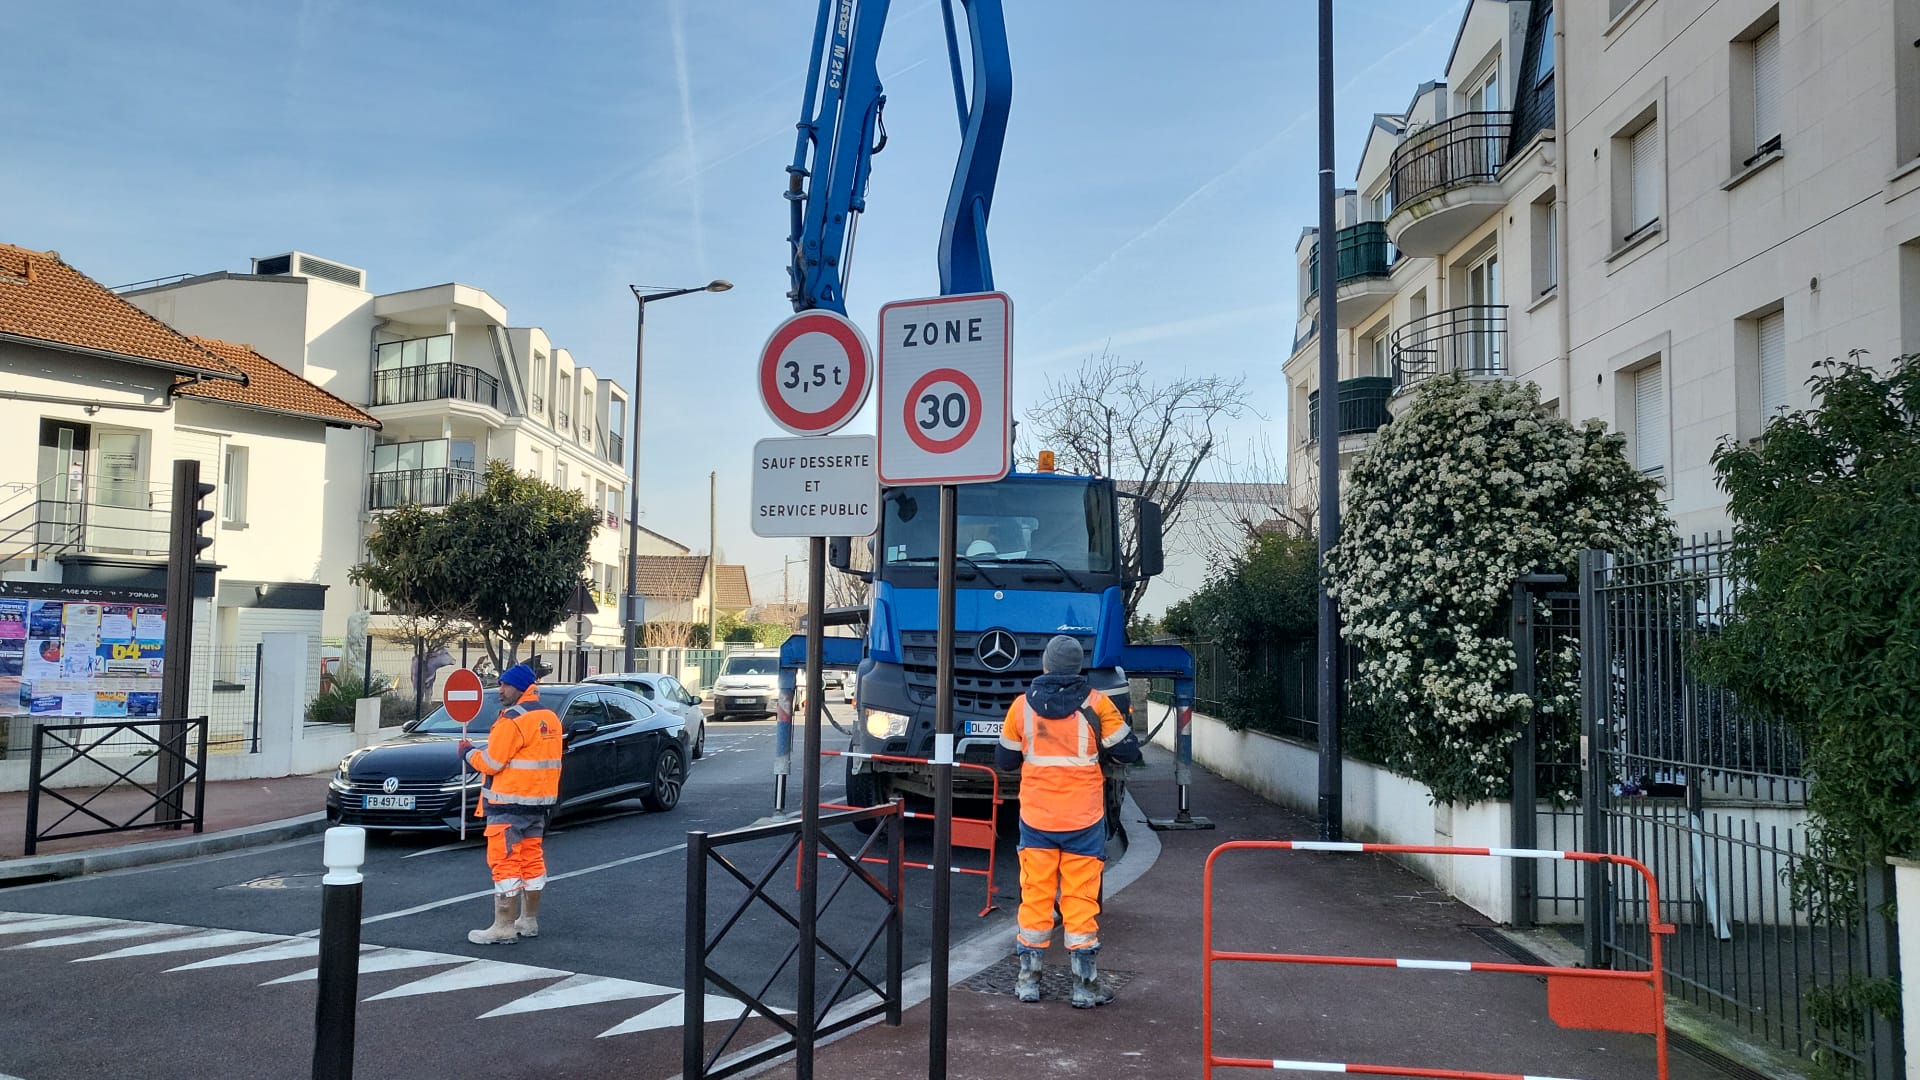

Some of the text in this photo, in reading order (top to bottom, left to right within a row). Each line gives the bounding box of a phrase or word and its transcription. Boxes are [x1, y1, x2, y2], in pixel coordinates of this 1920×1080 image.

[829, 0, 853, 89] ister M 21-3
[903, 318, 982, 348] ZONE
[783, 361, 842, 393] 3,5 t
[919, 392, 966, 430] 30
[761, 454, 869, 470] SAUF DESSERTE
[805, 480, 821, 493] ET
[760, 503, 868, 517] SERVICE PUBLIC
